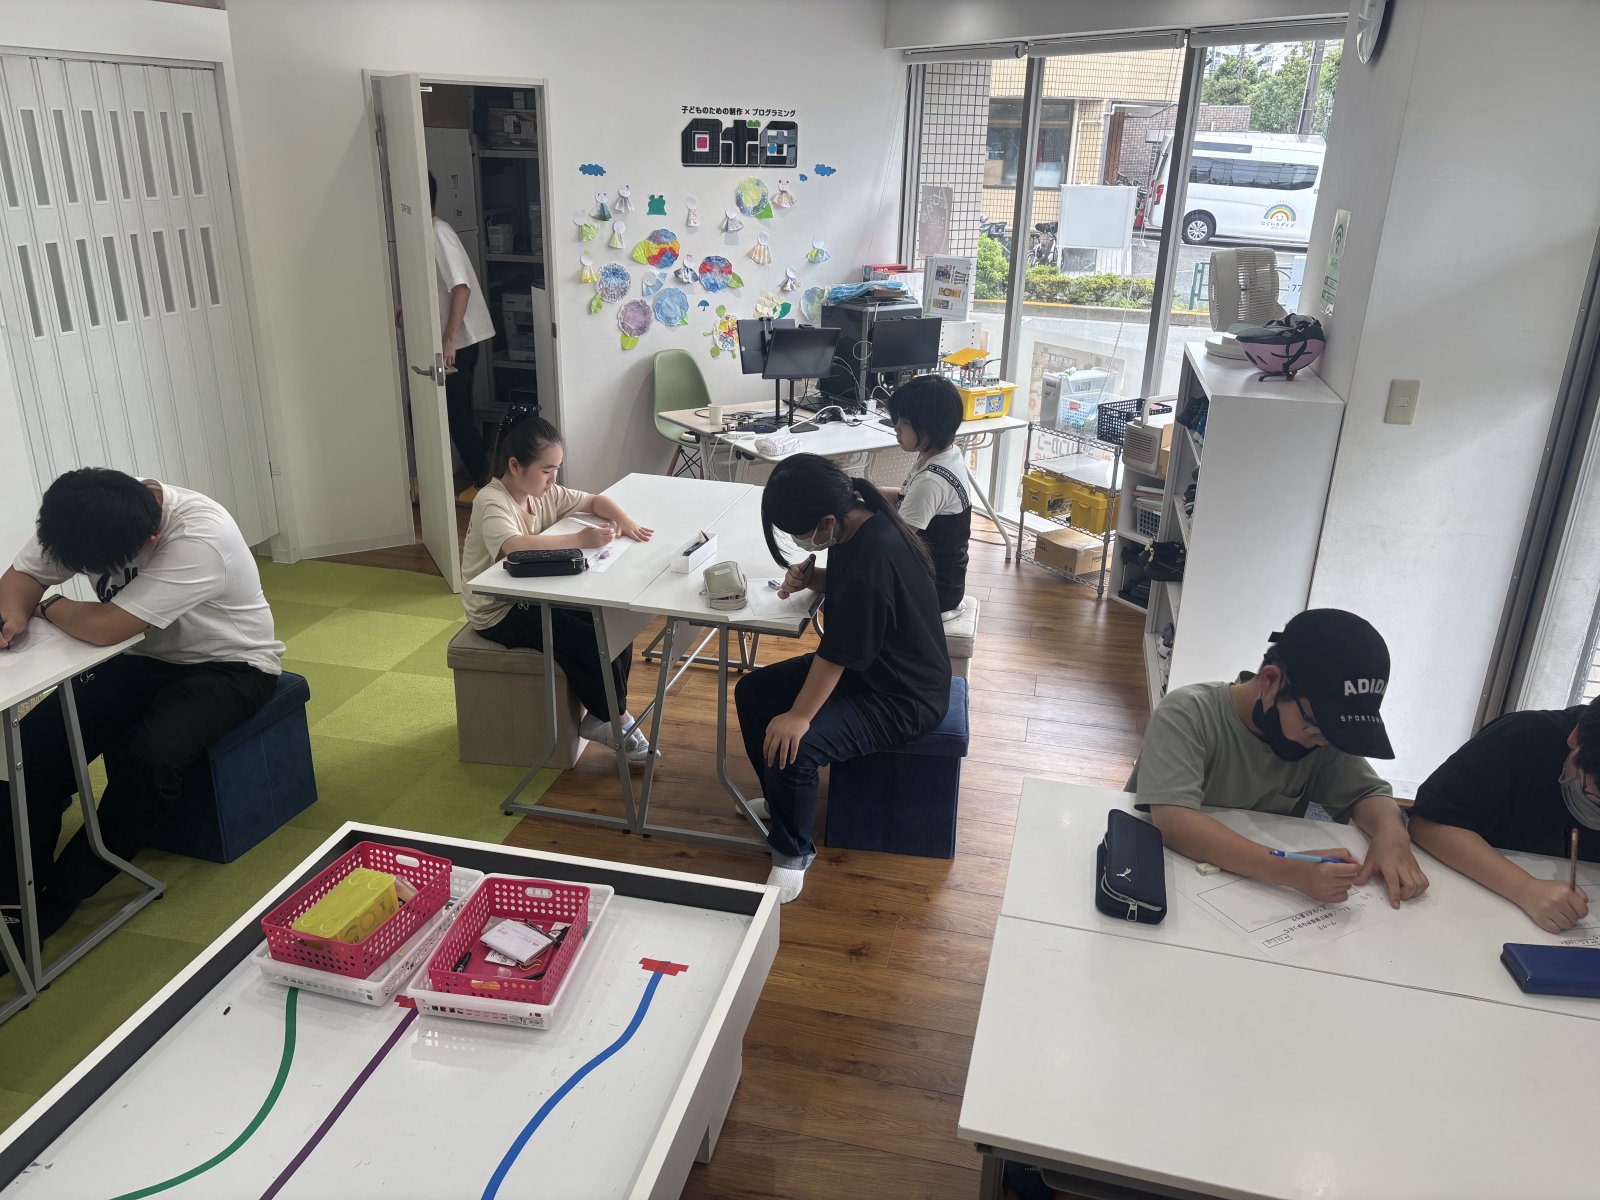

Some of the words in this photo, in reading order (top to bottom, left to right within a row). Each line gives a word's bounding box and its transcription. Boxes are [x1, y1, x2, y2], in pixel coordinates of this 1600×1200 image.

[681, 105, 743, 116] 子どものための制作
[752, 108, 796, 117] プログラミング
